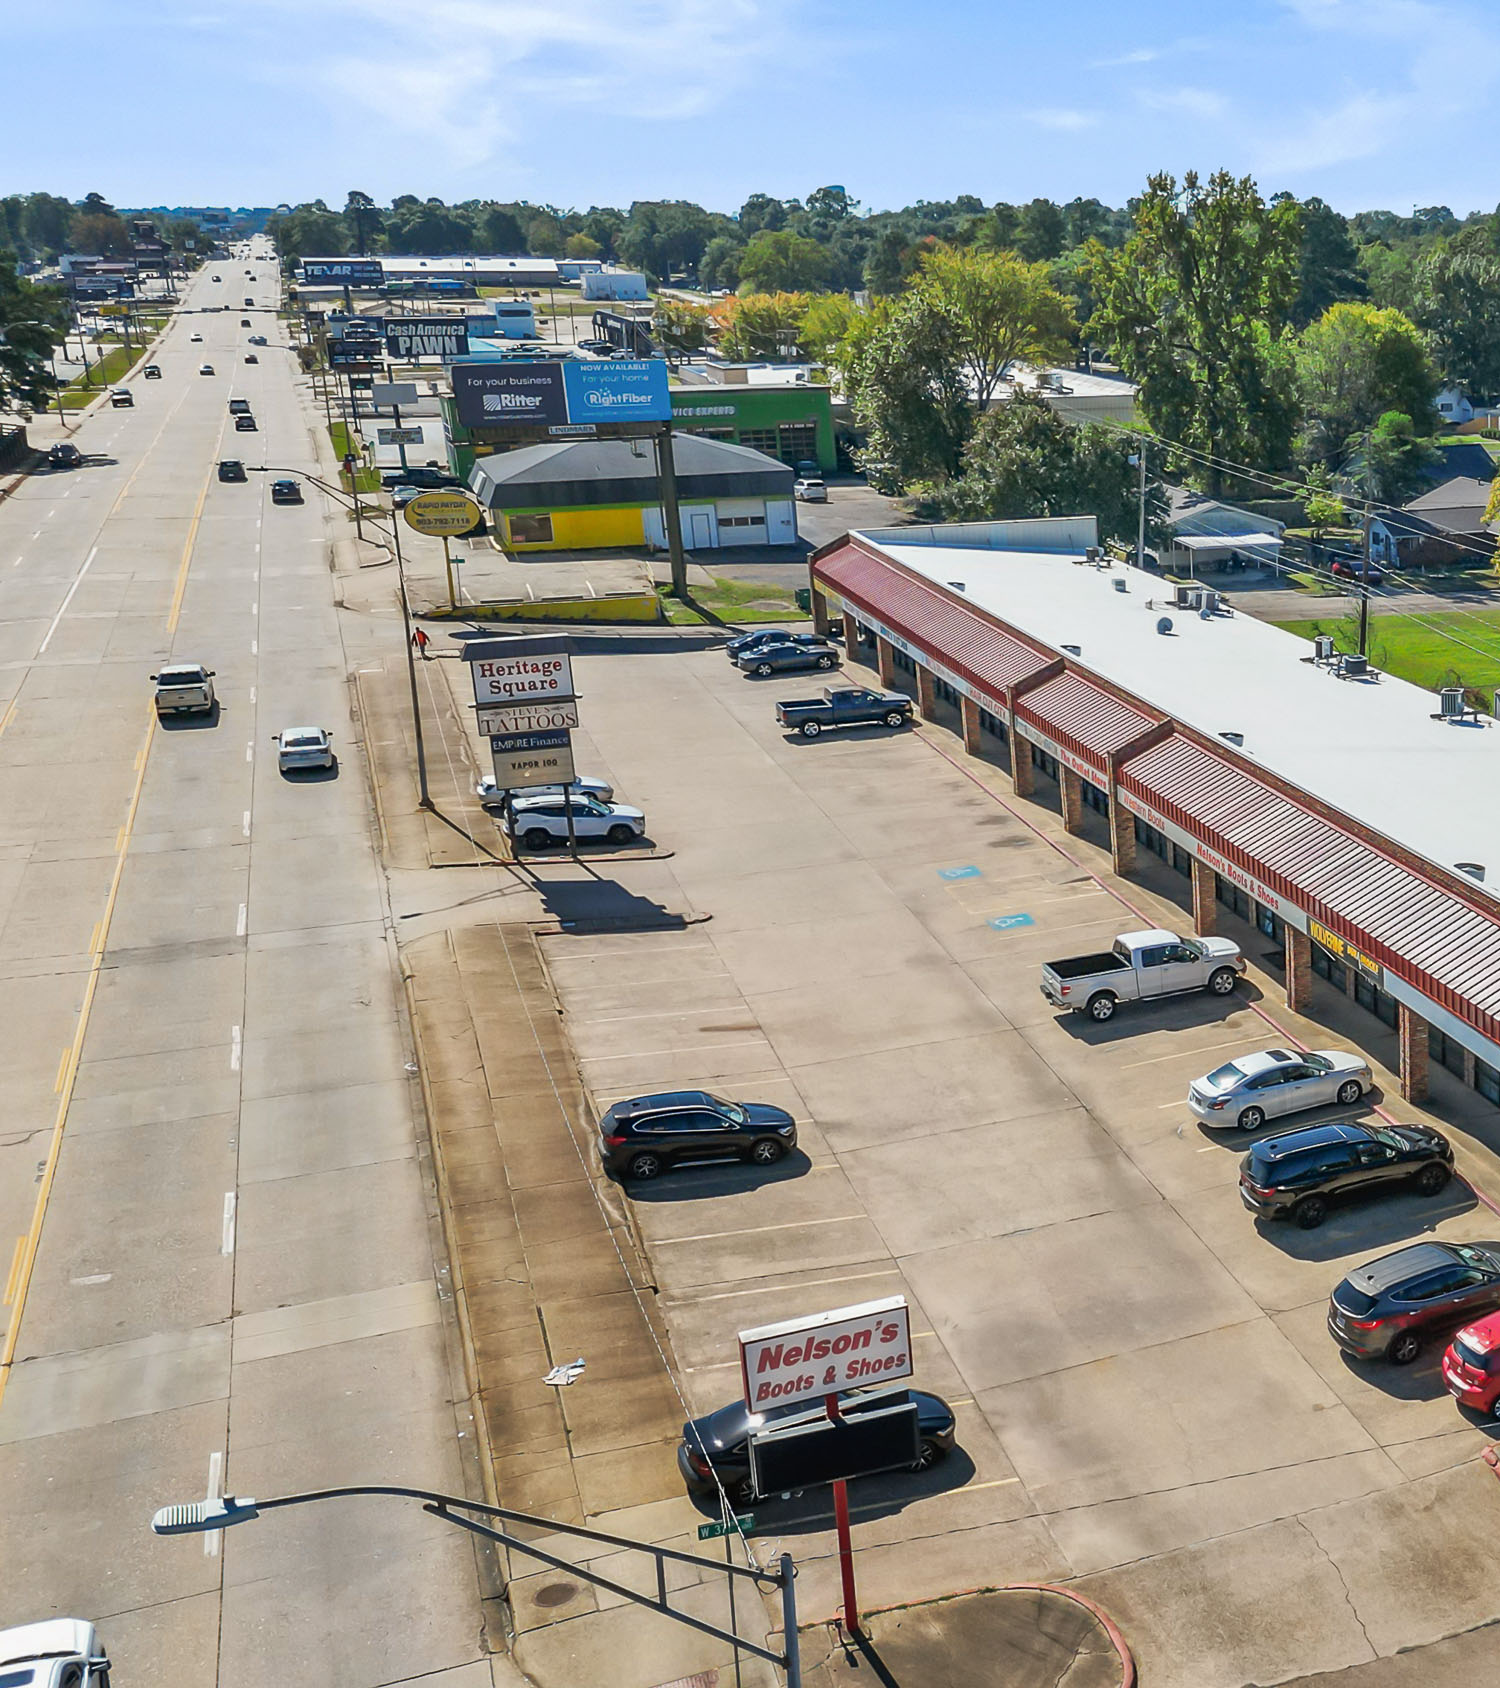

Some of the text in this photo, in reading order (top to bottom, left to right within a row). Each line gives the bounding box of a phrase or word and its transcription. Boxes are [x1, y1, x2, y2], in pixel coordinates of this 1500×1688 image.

[387, 324, 465, 336] Cash America
[398, 337, 458, 355] PAWN
[580, 363, 650, 372] NOW AVAILABLE!
[467, 376, 552, 388] For your business
[501, 393, 542, 407] Ritter
[589, 392, 653, 406] RightFiber
[672, 407, 692, 416] VICE
[479, 660, 562, 678] Heritage
[489, 678, 558, 697] Square
[481, 713, 576, 734] TATTOOS
[493, 736, 569, 751] EMPIRE Finance
[511, 760, 540, 770] VAPOR
[1123, 791, 1166, 832] Western Boots
[1196, 842, 1226, 873] Nelson's
[1227, 862, 1248, 890] Boots
[1249, 878, 1256, 894] &
[1257, 885, 1279, 910] Shoes
[1309, 919, 1345, 958] WOLVERINE
[757, 1320, 899, 1374] Nelson's
[756, 1352, 907, 1402] Boots & Shoes
[700, 1527, 710, 1538] W
